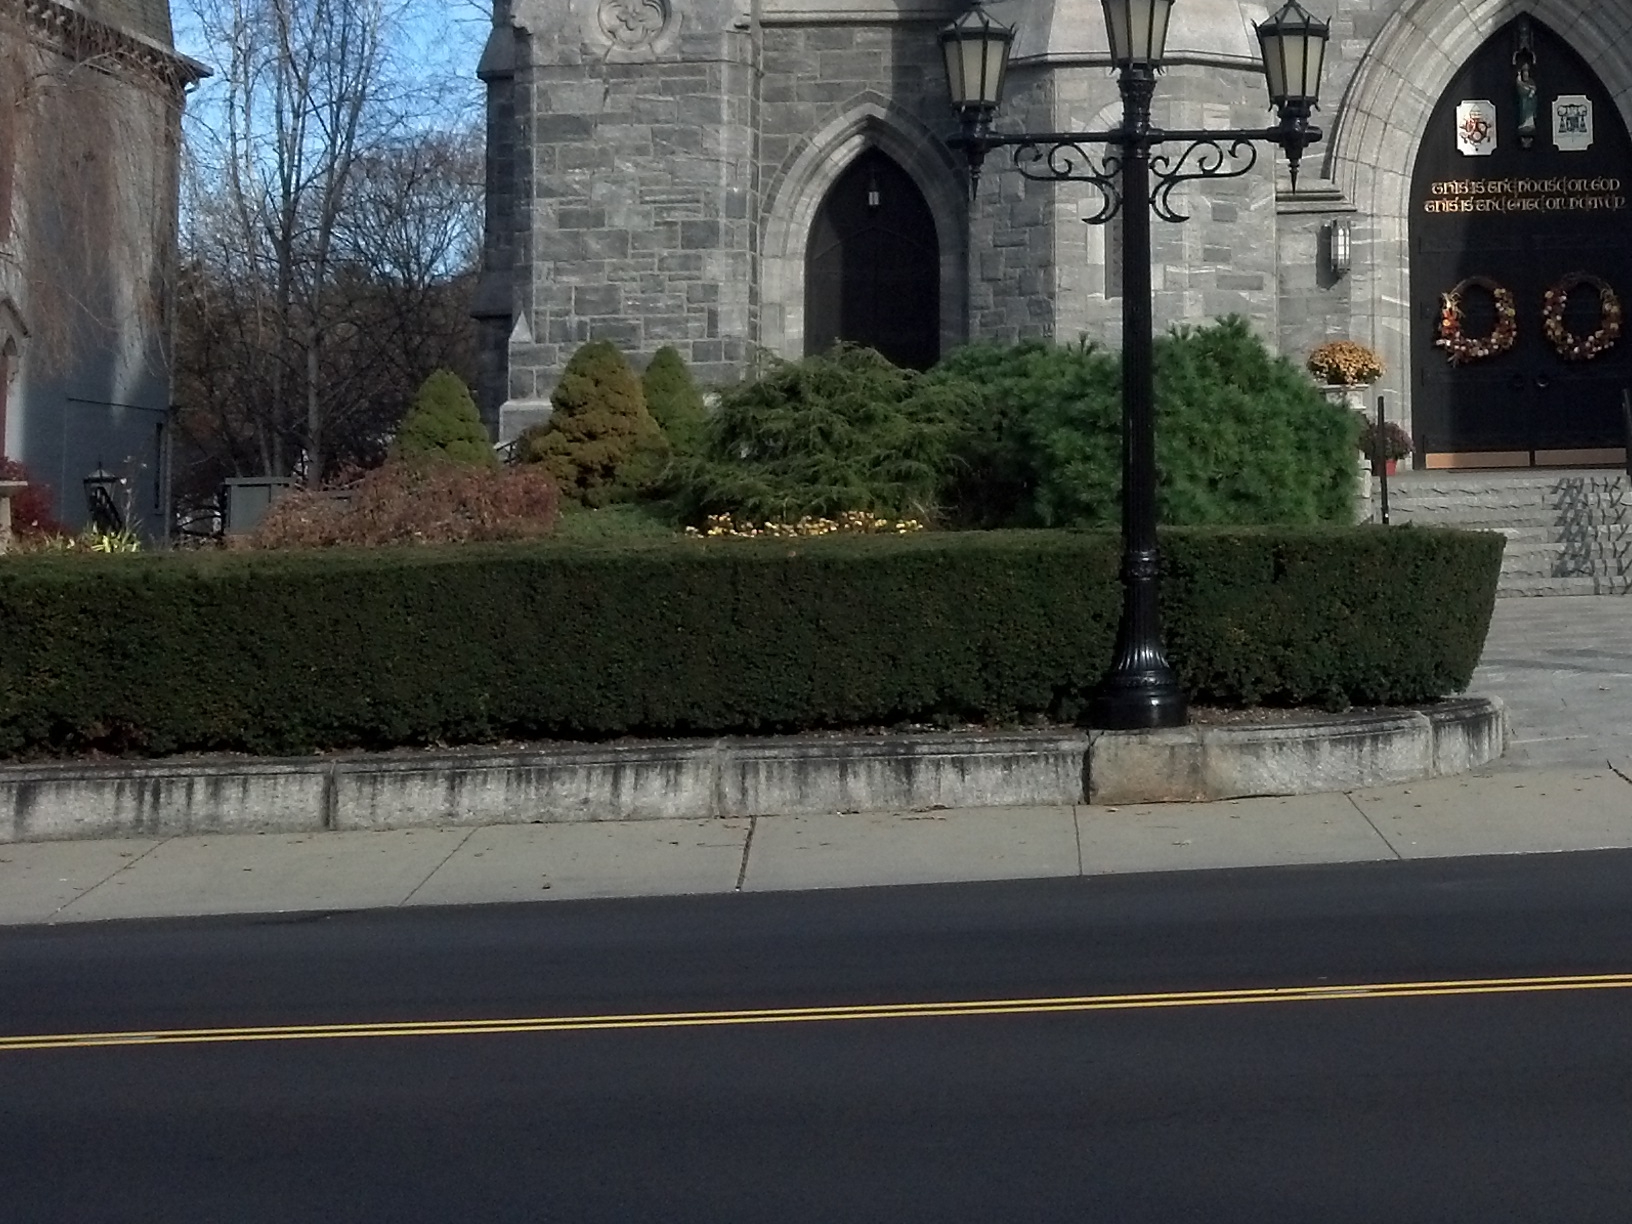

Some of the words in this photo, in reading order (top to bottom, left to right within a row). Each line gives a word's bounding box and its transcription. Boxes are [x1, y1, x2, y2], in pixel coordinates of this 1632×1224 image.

[1431, 179, 1469, 194] THIS
[1471, 178, 1485, 194] IS
[1487, 178, 1518, 197] THE
[1518, 177, 1567, 195] HOUSE
[1567, 178, 1589, 192] OF
[1590, 176, 1621, 191] GOD
[1424, 197, 1460, 213] THIS
[1460, 196, 1474, 212] IS
[1476, 196, 1506, 214] THE
[1507, 196, 1546, 213] GATE
[1545, 197, 1568, 210] OF
[1569, 195, 1626, 211] HEAVEN
